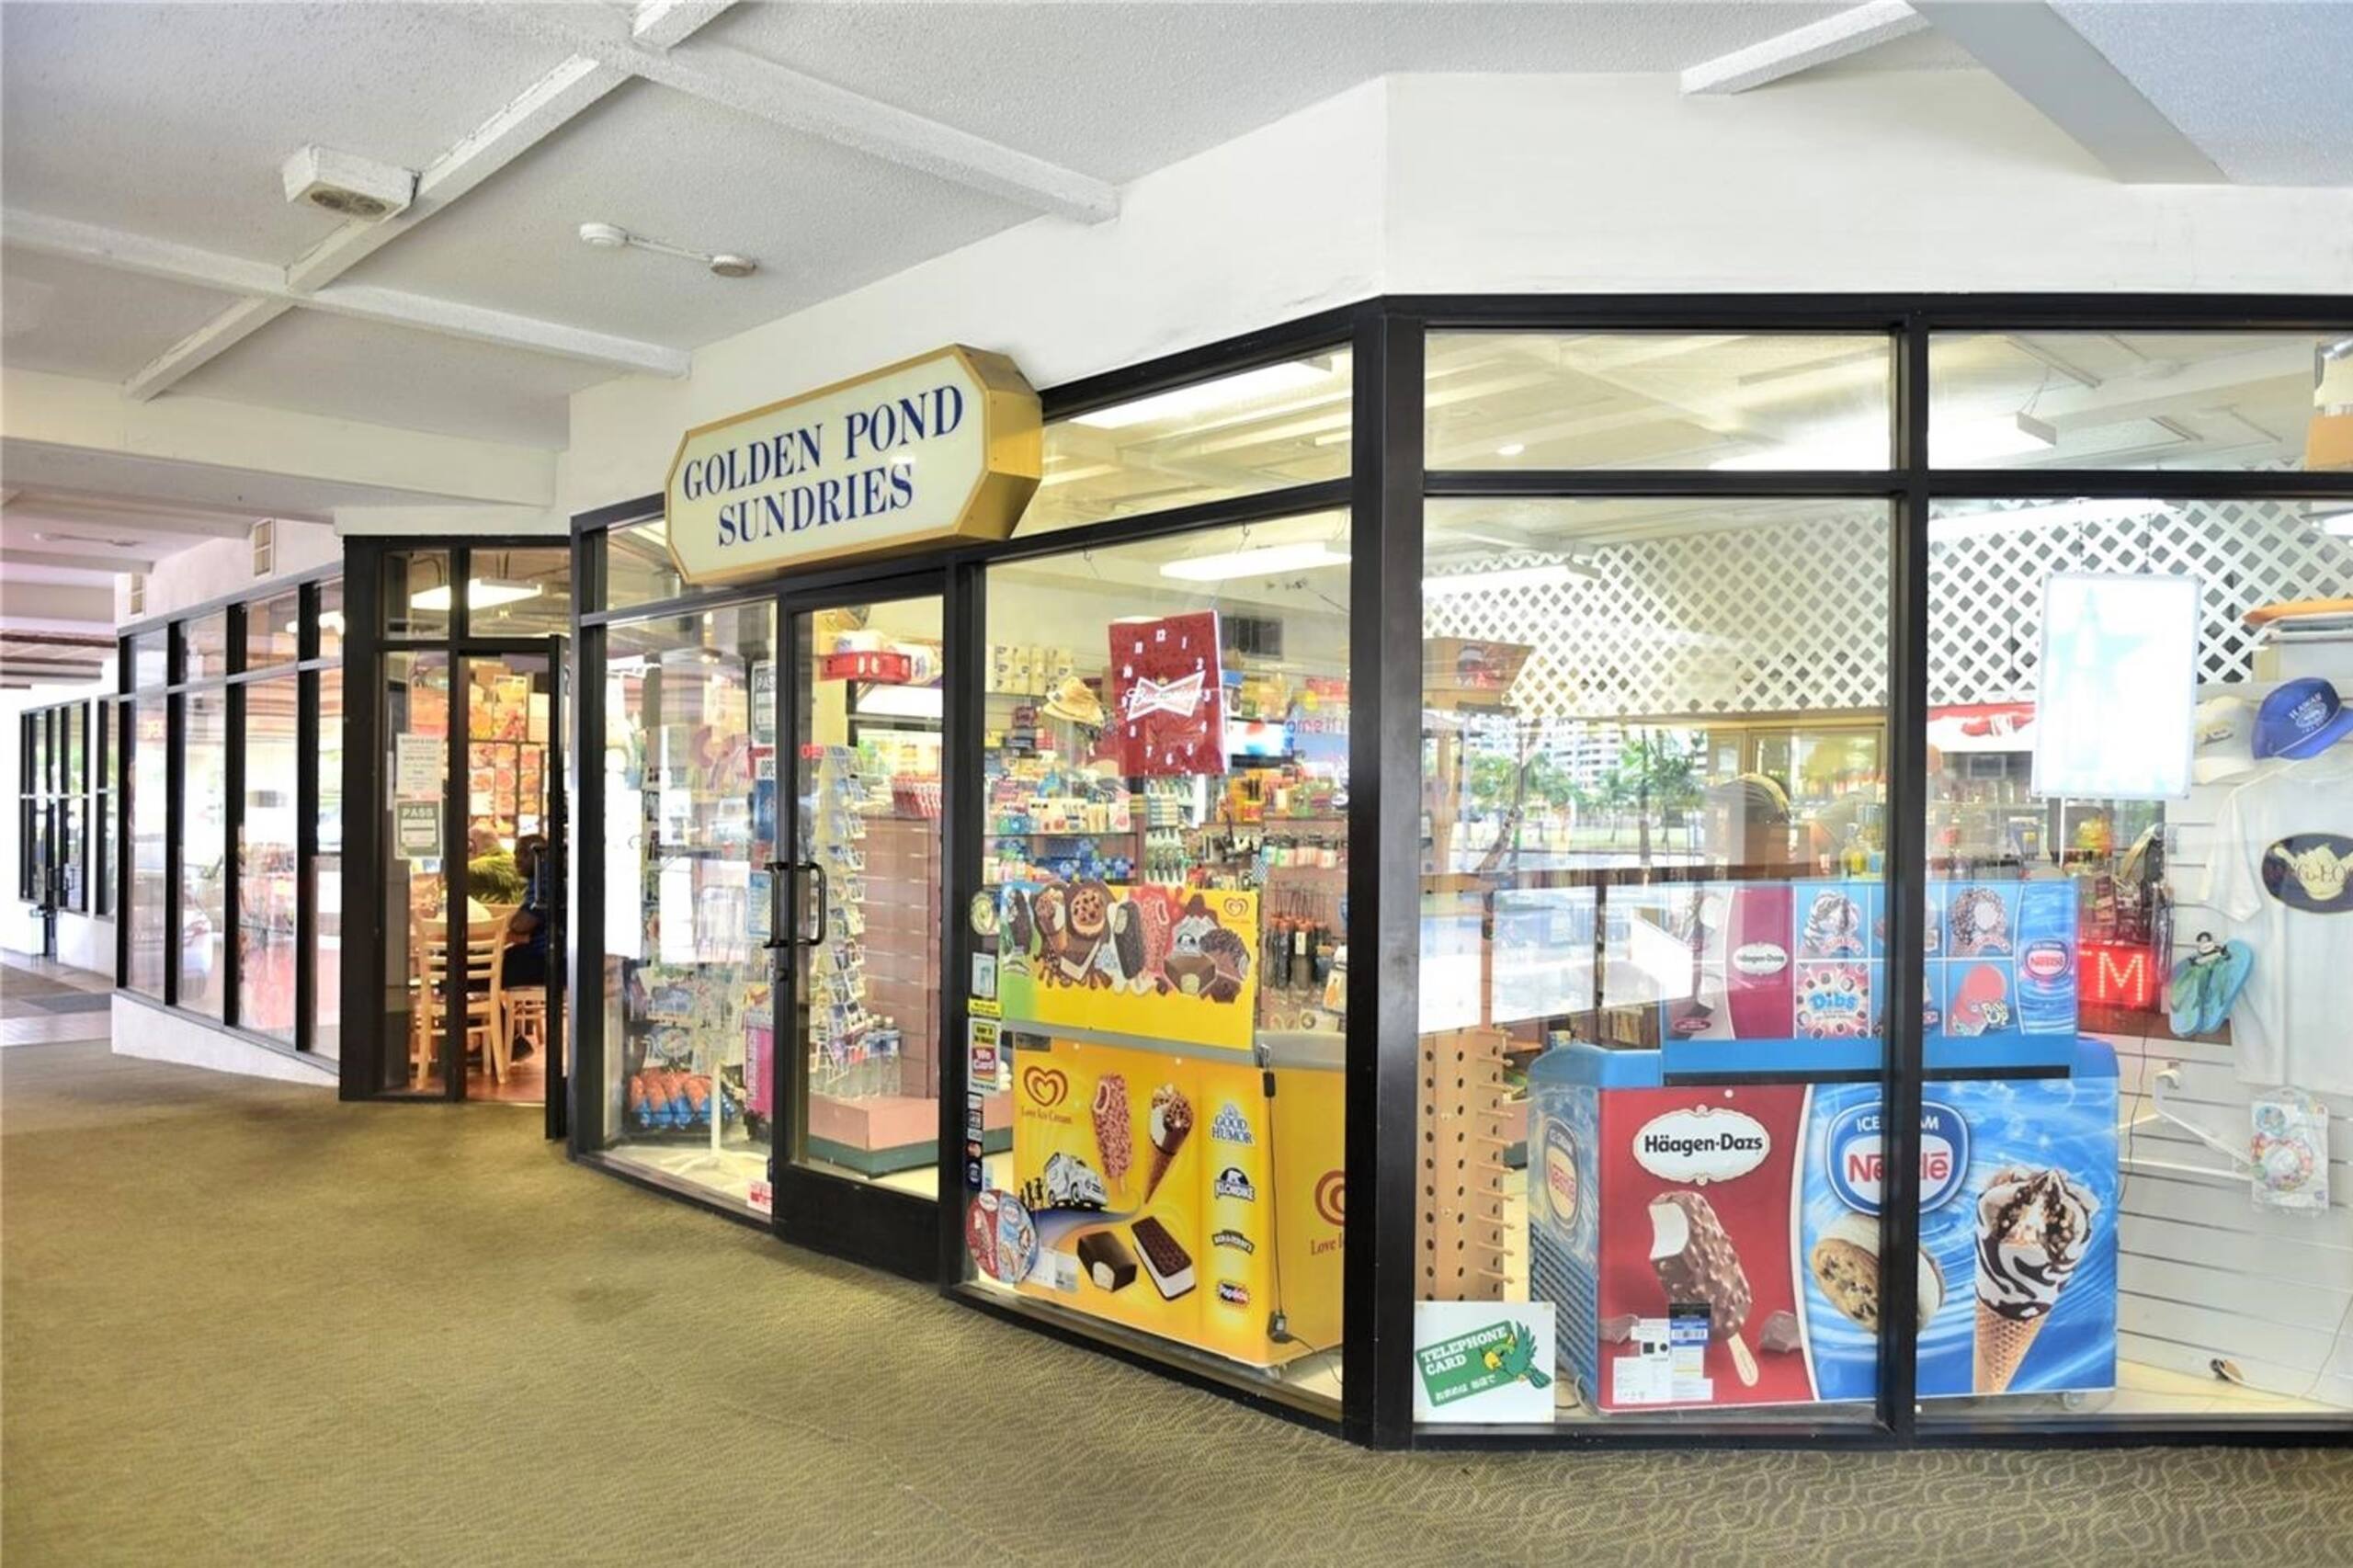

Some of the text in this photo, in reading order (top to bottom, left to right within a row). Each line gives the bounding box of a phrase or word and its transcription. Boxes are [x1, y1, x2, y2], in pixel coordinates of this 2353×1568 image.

[684, 384, 963, 501] GOLDEN POND
[718, 463, 915, 547] SUNDRIES
[756, 676, 776, 693] PAS
[1809, 992, 1858, 1011] Dibs
[1215, 1114, 1248, 1131] GOOD
[1857, 1115, 1881, 1132] ICE
[1211, 1125, 1252, 1144] HUMOR
[1644, 1132, 1763, 1157] Häagen-Dazs
[1848, 1152, 1948, 1183] Nelé
[1311, 1238, 1336, 1256] Love
[1420, 1325, 1507, 1363] TELEPHONE
[1426, 1353, 1467, 1376] CARD
